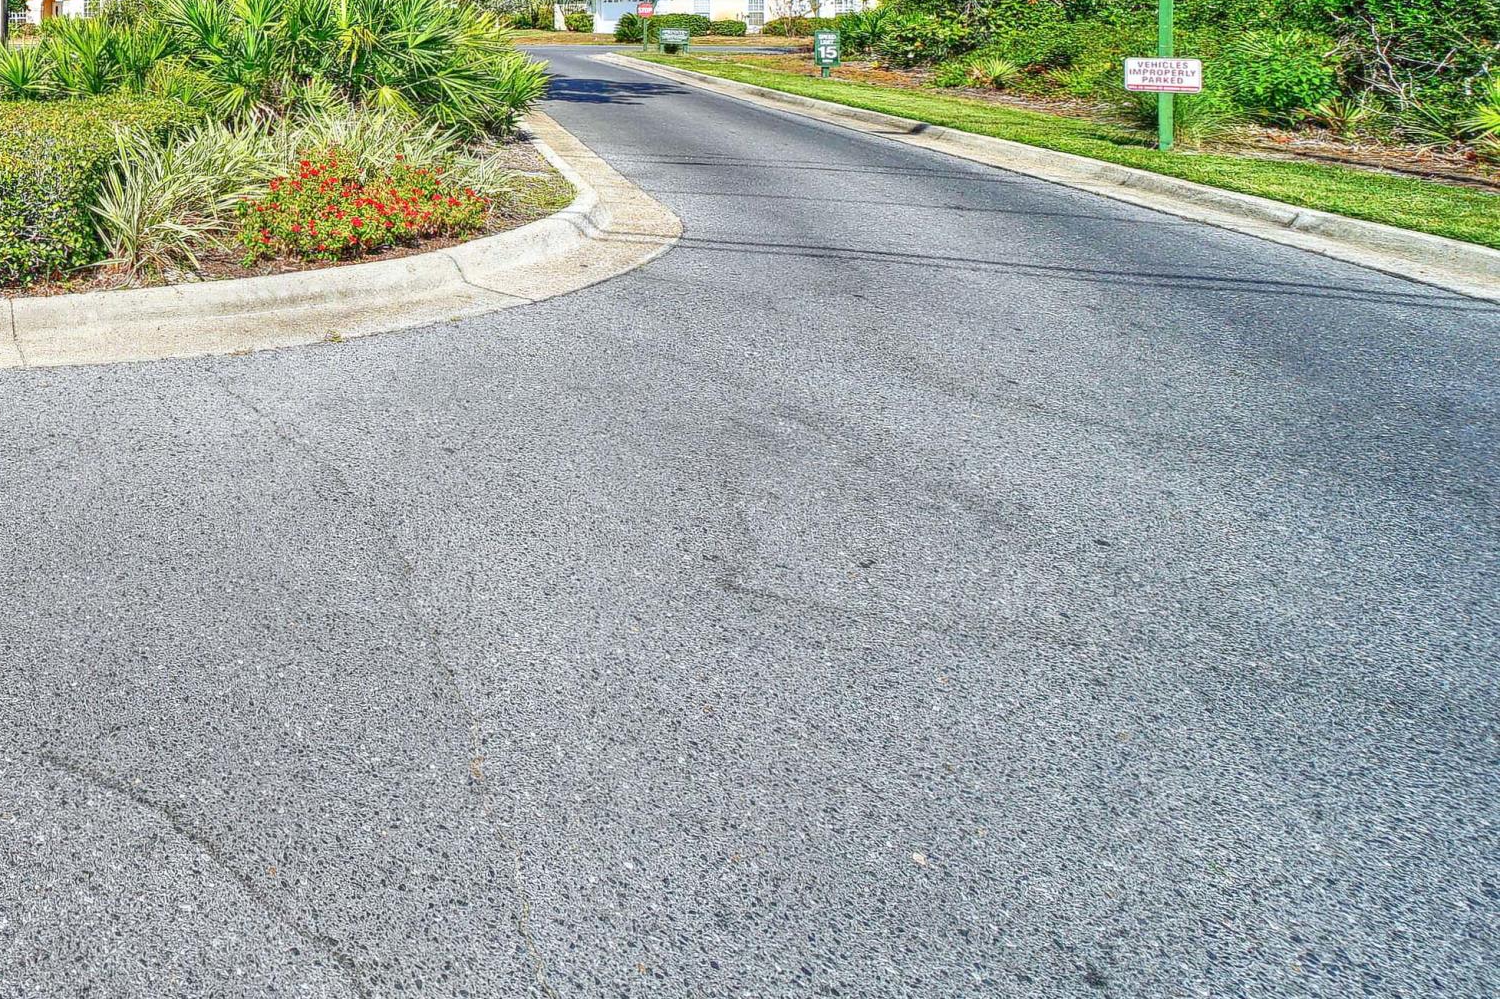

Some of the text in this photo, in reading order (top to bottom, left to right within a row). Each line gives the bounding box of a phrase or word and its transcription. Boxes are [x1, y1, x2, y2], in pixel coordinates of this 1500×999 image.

[817, 45, 838, 58] 15
[1137, 61, 1189, 69] VEHICLES
[1129, 68, 1196, 77] IMPROPERLY
[1141, 76, 1184, 84] PARKED
